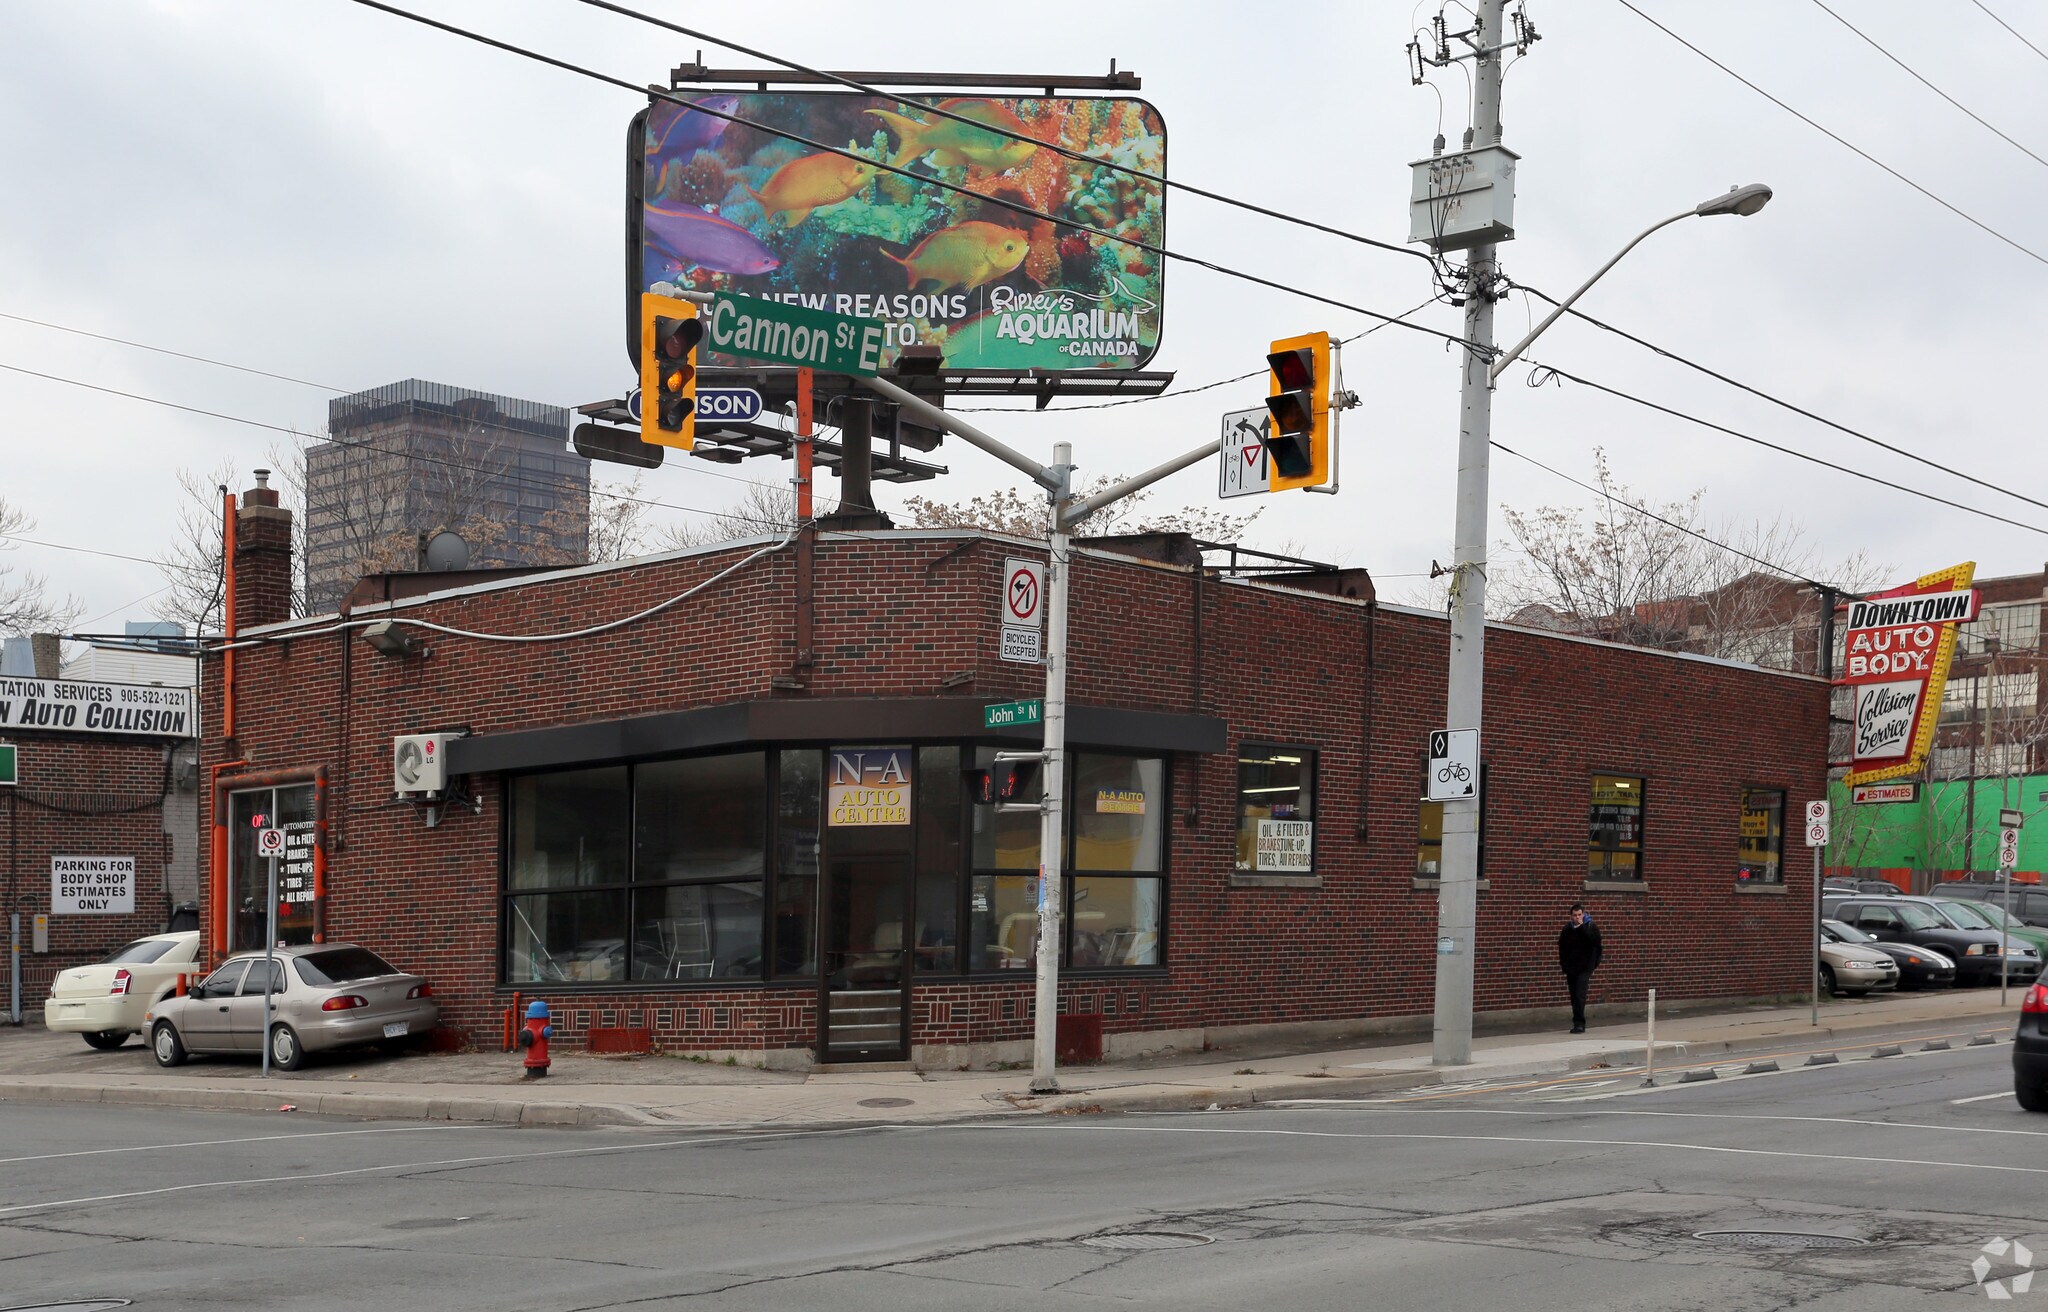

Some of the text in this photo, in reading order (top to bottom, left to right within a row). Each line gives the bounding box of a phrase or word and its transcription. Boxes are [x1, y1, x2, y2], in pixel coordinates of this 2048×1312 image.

[836, 294, 967, 319] REASONS
[996, 309, 1139, 345] AQUARIUM
[711, 300, 828, 363] Cannon
[835, 322, 855, 350] St
[858, 326, 882, 371] E
[1059, 341, 1139, 356] OF CANADA
[1850, 595, 1970, 630] DOWNTOWN
[1006, 632, 1036, 646] BICYCLES
[1850, 626, 1934, 654] AUTO
[1004, 644, 1037, 658] EXCEPTED
[1850, 649, 1930, 677] BODY
[0, 680, 186, 706] TATION SERVICES 905-522-1221
[989, 704, 1037, 724] John St N
[1858, 687, 1917, 729] Collision
[20, 699, 77, 727] AUTO
[85, 702, 186, 733] COLLISION
[1857, 718, 1909, 755] Service
[833, 752, 909, 785] N-A
[839, 790, 901, 807] AUTO
[1099, 790, 1144, 802] N-A AUTO
[1867, 788, 1911, 800] ESTIMATES
[1102, 801, 1140, 813] CENTRE
[252, 814, 272, 828] OPEN
[832, 807, 906, 824] CENTRE
[1262, 824, 1273, 837] OIL
[1277, 823, 1282, 837] &
[1282, 823, 1304, 837] FILTER
[287, 835, 296, 846] OIL
[296, 835, 300, 845] &
[286, 848, 308, 860] BRAKES
[1258, 852, 1277, 869] TIRES,
[1287, 853, 1312, 867] REPAIRS
[54, 860, 133, 871] PARKING FOR
[286, 862, 313, 875] TUNE-UPS
[61, 873, 127, 884] BODY SHOP
[286, 877, 303, 889] TIRES
[61, 886, 126, 897] ESTIMATES
[286, 892, 296, 903] ALL
[78, 899, 109, 910] ONLY
